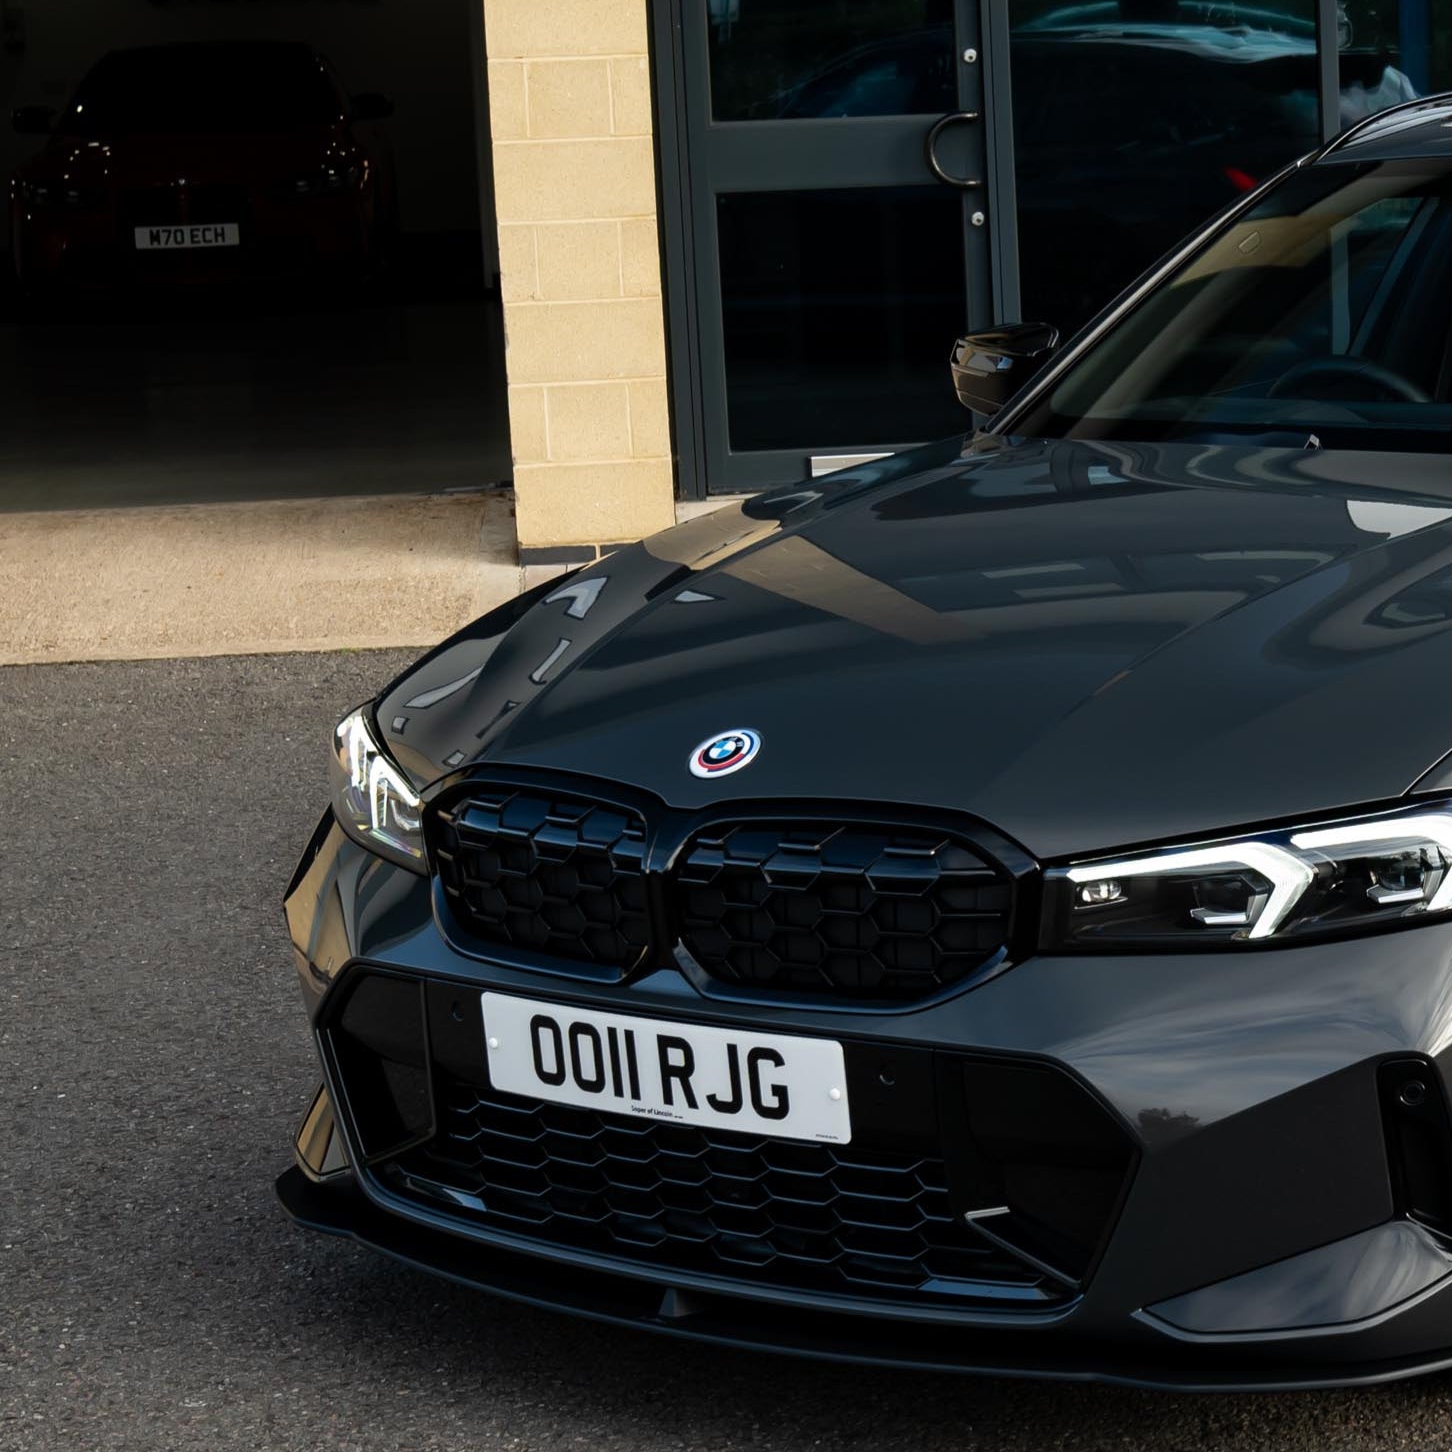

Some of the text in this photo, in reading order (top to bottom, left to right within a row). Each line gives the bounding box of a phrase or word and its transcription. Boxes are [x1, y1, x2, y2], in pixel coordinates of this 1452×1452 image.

[149, 226, 226, 246] M70 ECH
[656, 1033, 790, 1120] RJG
